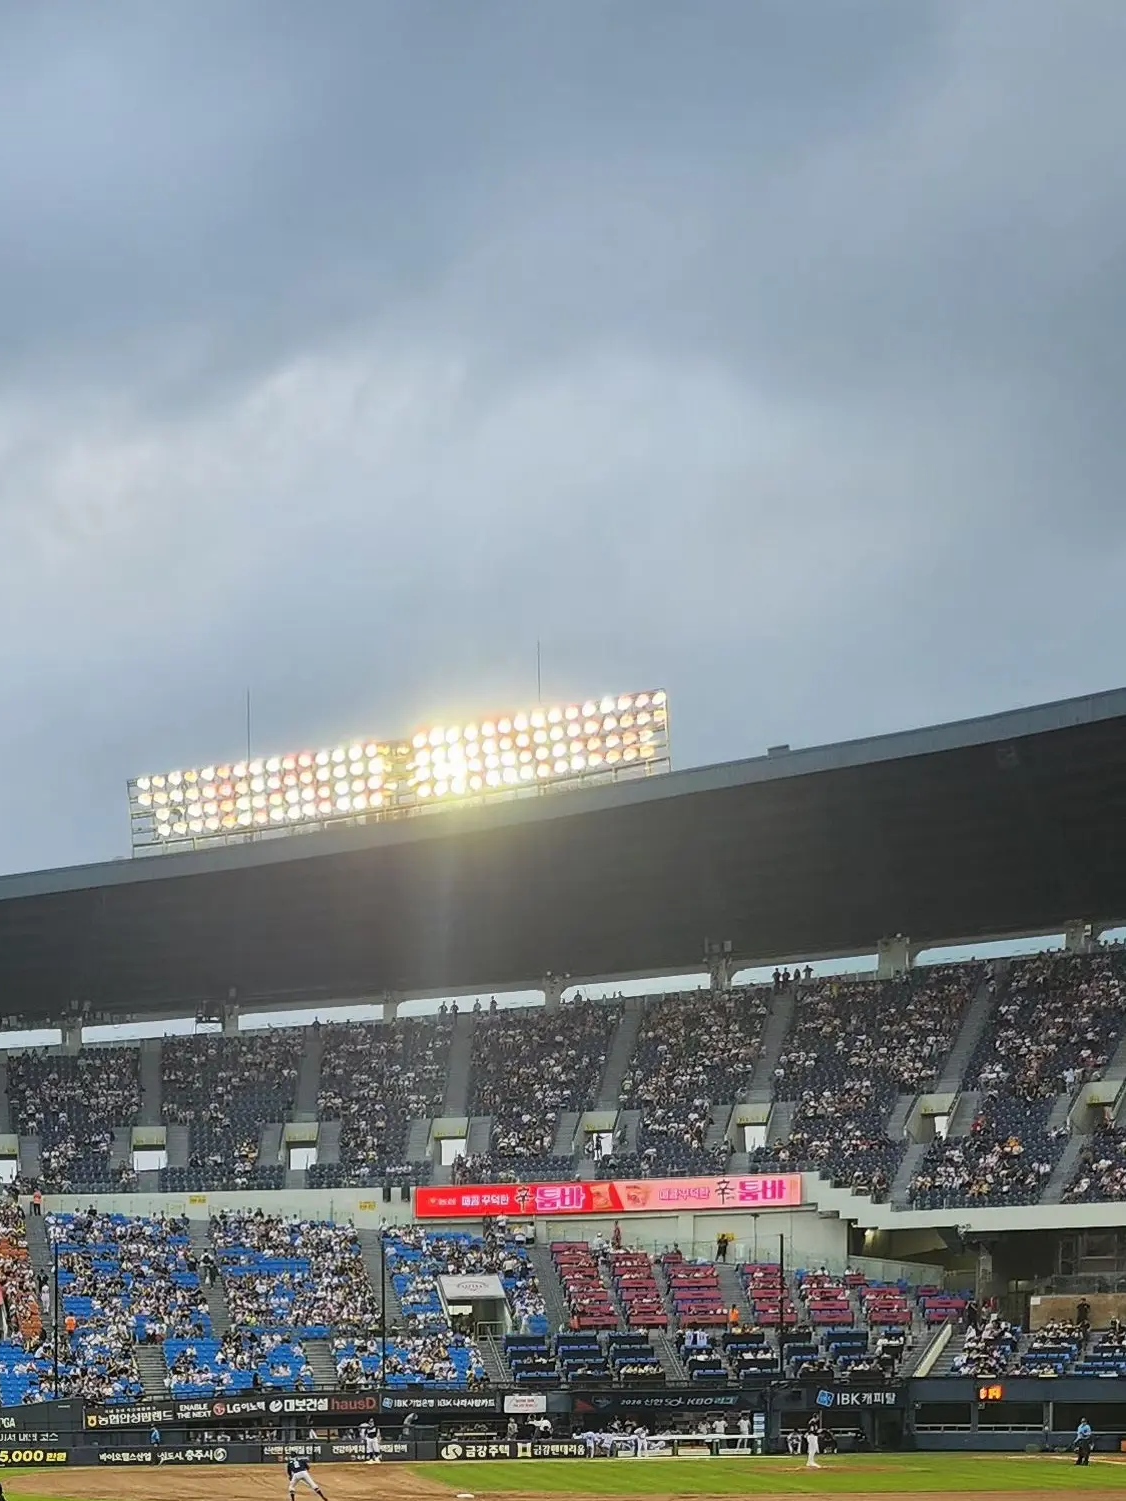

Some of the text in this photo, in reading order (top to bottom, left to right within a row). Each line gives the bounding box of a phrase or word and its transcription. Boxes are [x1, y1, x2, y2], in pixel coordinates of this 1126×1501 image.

[739, 1179, 786, 1201] 툼바
[536, 1186, 585, 1211] 툼바
[179, 1403, 209, 1411] ENABLE
[330, 1397, 376, 1410] hausD
[687, 1398, 713, 1406] KBO
[177, 1410, 212, 1419] THE NEXT
[185, 1449, 213, 1461] 충주시
[465, 1444, 510, 1458] 금강주택
